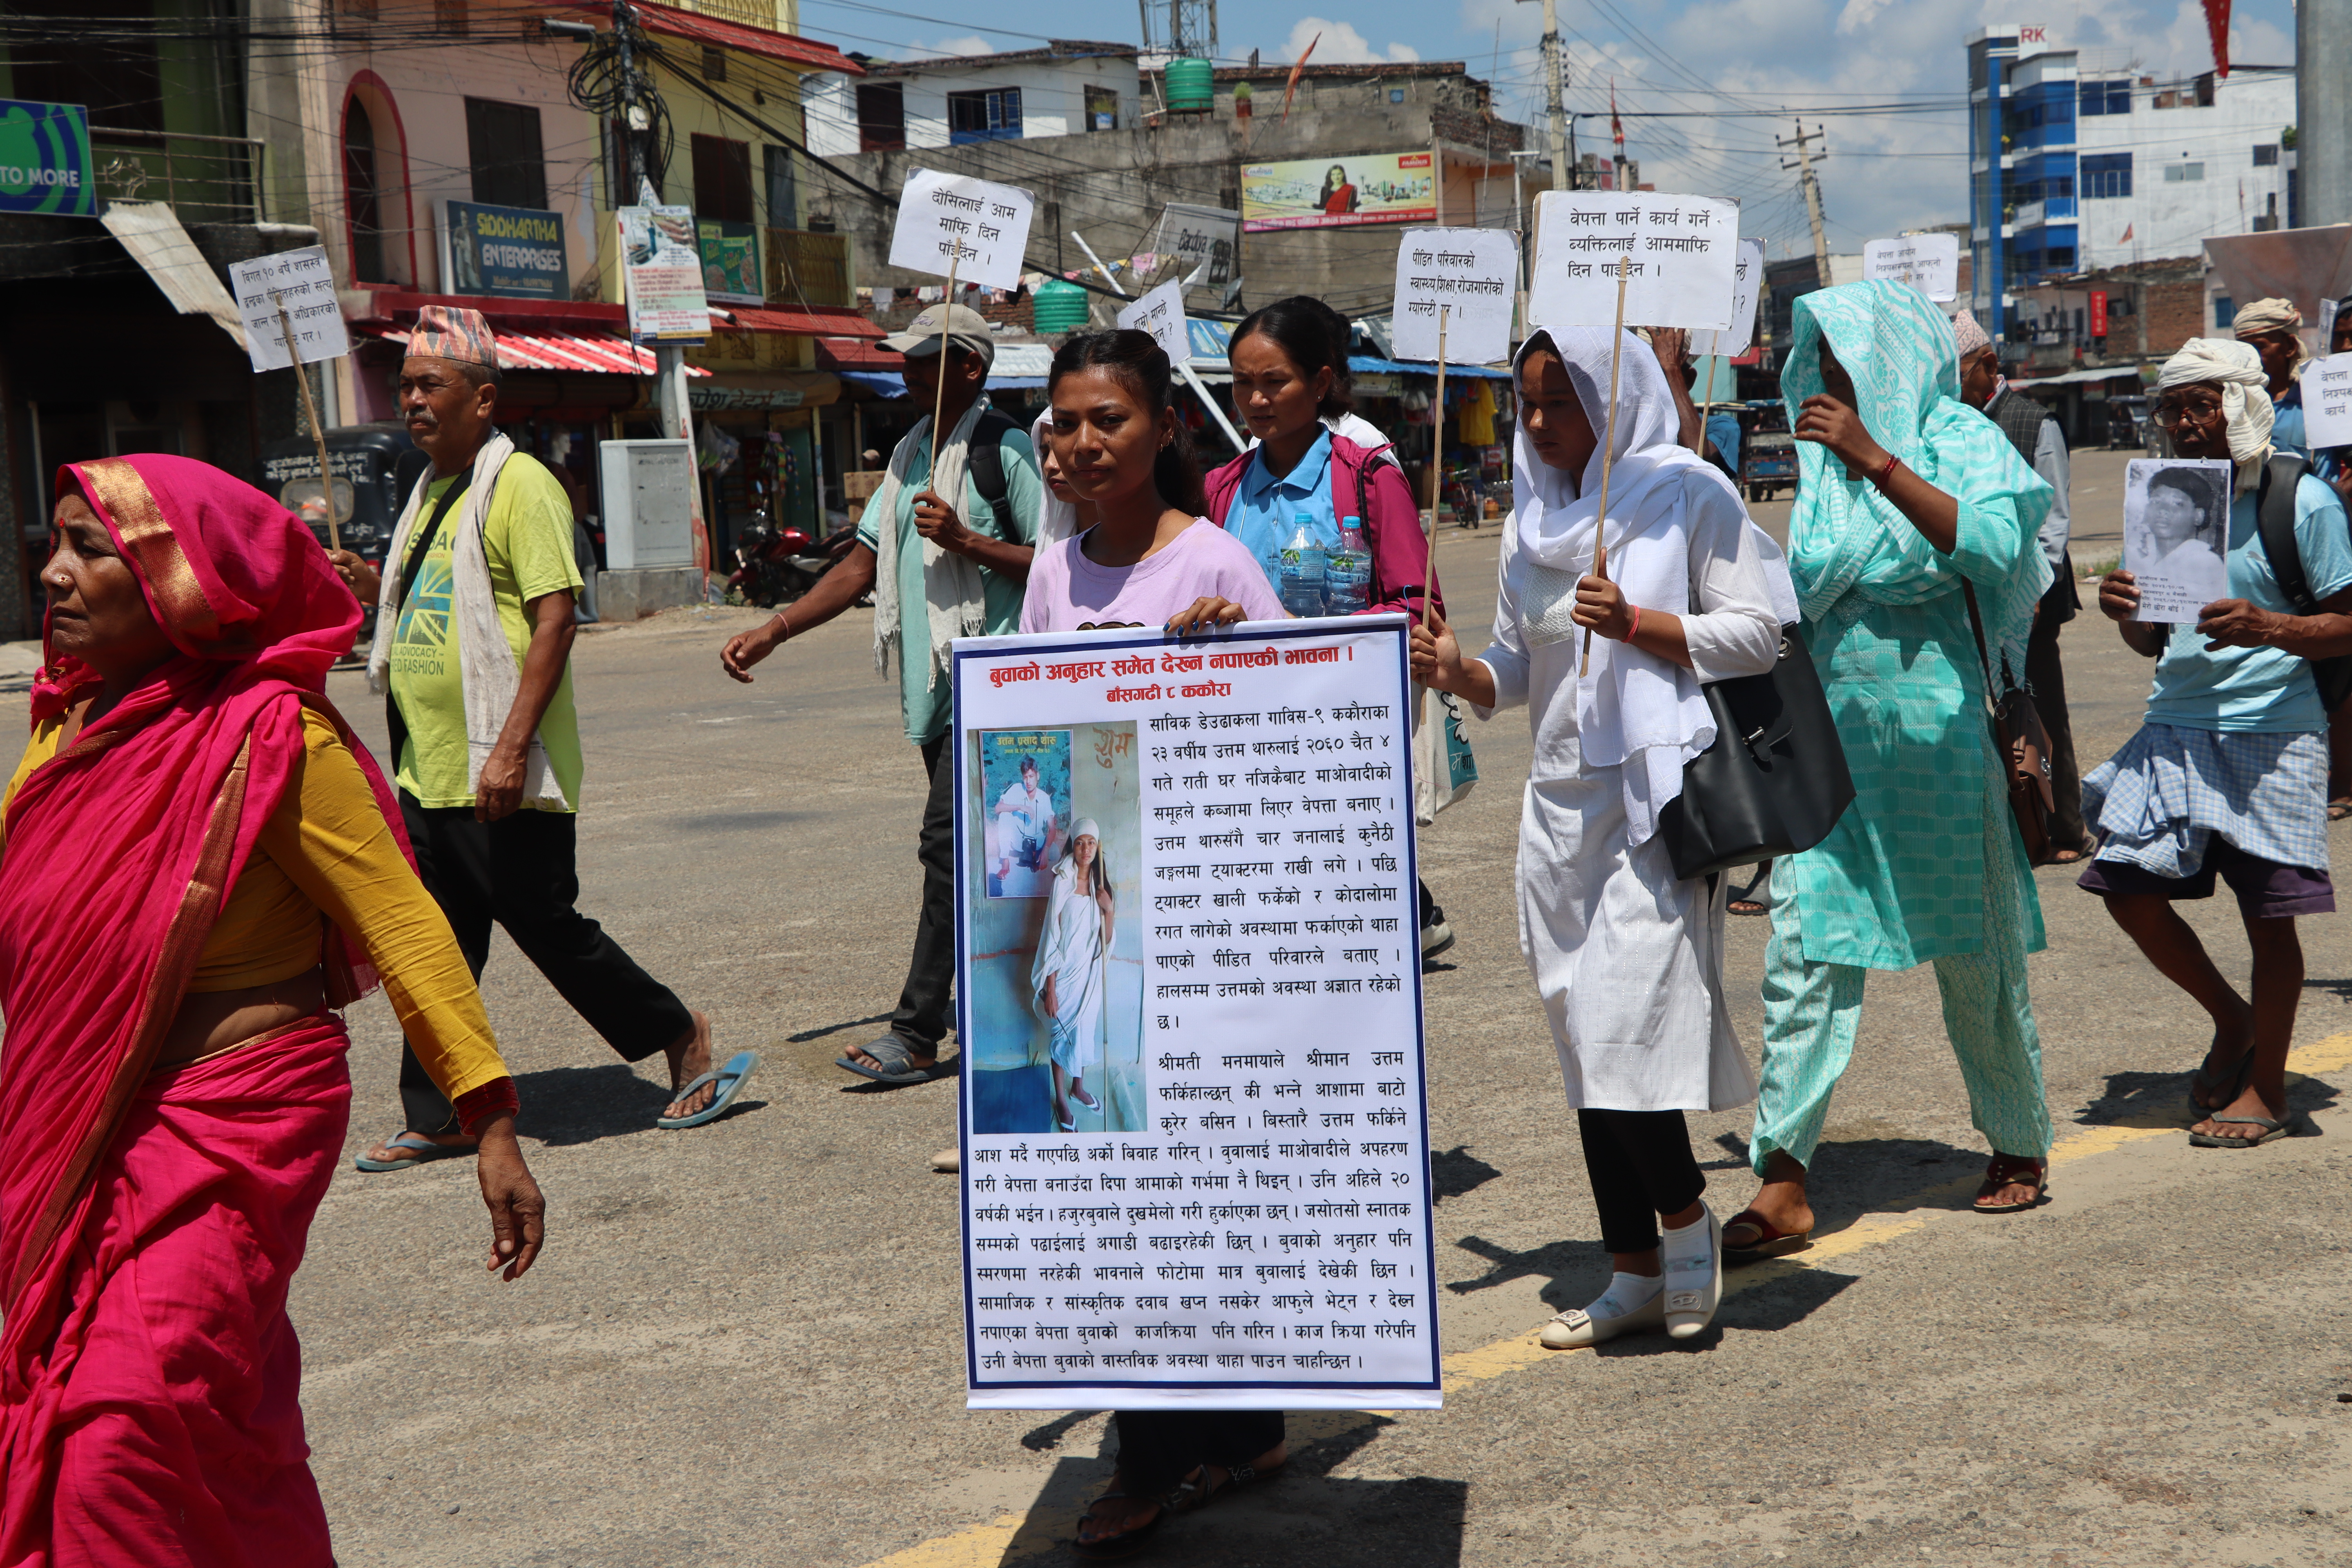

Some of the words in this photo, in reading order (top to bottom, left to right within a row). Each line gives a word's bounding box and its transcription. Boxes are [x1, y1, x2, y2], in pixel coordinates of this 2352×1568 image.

[2021, 27, 2046, 43] RK
[0, 166, 23, 183] TO
[29, 168, 80, 187] MORE
[932, 188, 985, 212] दोसिलाई
[991, 203, 1016, 220] आम
[1649, 208, 1680, 226] कार्य
[1688, 210, 1711, 228] गर्ने
[939, 217, 972, 235] माफि
[978, 222, 1001, 242] दिन
[483, 243, 562, 272] ENTERPRISES
[1413, 248, 1433, 267] पीडित
[1437, 250, 1475, 269] परिवारको
[241, 270, 262, 284] विगत
[263, 268, 274, 281] १०
[1568, 260, 1592, 278] दिन
[293, 299, 337, 321] अधिकारको
[1151, 299, 1167, 320] मान्छे
[301, 331, 314, 343] गर
[2324, 402, 2346, 417] कार्य
[2142, 602, 2151, 610] मेरो
[2154, 603, 2166, 611] छोरा
[400, 646, 437, 658] ADVOCACY
[404, 659, 444, 675] FASHION
[990, 661, 1040, 688] बुवाको
[1045, 661, 1106, 683] अनुहार
[1111, 655, 1155, 677] समेत
[1161, 652, 1204, 673] देख्न
[1209, 646, 1279, 669] नपाएकी
[1285, 647, 1339, 664] भावना
[1107, 683, 1161, 702] बाँसगढी
[1166, 686, 1176, 699] ८
[1181, 679, 1232, 698] ककौरा
[1149, 713, 1191, 731] साविक
[1198, 711, 1260, 729] डेउढाकला
[1332, 701, 1389, 721] ककौराका
[1152, 747, 1167, 762] २३
[1173, 741, 1207, 760] वर्षीय
[1213, 744, 1245, 758] उत्तम
[1252, 735, 1299, 756] थारुलाई
[1307, 738, 1343, 754] २०६०
[1350, 731, 1373, 750] चैत
[1380, 735, 1389, 747] ४
[1152, 773, 1173, 791] गते
[1182, 771, 1209, 789] राती
[1218, 775, 1236, 787] घर
[1245, 766, 1306, 786] नजिकैबाट
[1316, 762, 1392, 782] माओवादीको
[1153, 801, 1195, 825] समूहले
[1261, 798, 1293, 818] लिएर
[1302, 796, 1337, 813] वेपत्ता
[1346, 797, 1381, 813] बनाए
[1284, 856, 1313, 875] राखी
[1323, 855, 1347, 873] लगे
[1371, 853, 1397, 872] पछि
[1213, 889, 1246, 907] खाली
[1258, 886, 1301, 905] फर्केको
[1314, 891, 1322, 903] र
[1334, 883, 1397, 902] कोदालोमा
[1156, 950, 1195, 971] पाएको
[1212, 949, 1251, 967] पीडित
[1269, 946, 1325, 965] परिवारले
[1343, 949, 1378, 965] बताए
[1157, 985, 1210, 999] हालसम्म
[1216, 978, 1265, 997] उत्तमको
[1273, 981, 1317, 995] अवस्था
[1324, 980, 1362, 993] अज्ञात
[1368, 974, 1401, 993] रहेको
[1157, 1016, 1169, 1029] छ
[1159, 1052, 1201, 1071] श्रीमती
[1221, 1050, 1285, 1069] मनमायाले
[1307, 1049, 1350, 1067] श्रीमान
[1371, 1052, 1404, 1065] उत्तम
[1244, 1080, 1261, 1098] की
[1274, 1080, 1302, 1098] भन्ने
[1316, 1083, 1365, 1097] आशामा
[1377, 1077, 1406, 1096] बाटो
[1160, 1112, 1187, 1136] कुरेर
[1200, 1112, 1236, 1129] बसिन
[1263, 1108, 1308, 1128] बिस्तारै
[1320, 1114, 1354, 1127] उत्तम
[1367, 1107, 1407, 1126] फर्किने
[975, 1150, 1001, 1163] आश
[1009, 1143, 1028, 1162] मर्दै
[1036, 1144, 1080, 1165] गएपछि
[1088, 1143, 1114, 1161] अर्को
[1122, 1143, 1158, 1161] बिवाह
[1167, 1142, 1202, 1163] गरिन्
[1278, 1139, 1351, 1158] माओवादीले
[1361, 1143, 1408, 1156] अपहरण
[981, 1351, 1005, 1369] उनी
[1012, 1351, 1047, 1368] बेपत्ता
[1053, 1350, 1095, 1373] बुवाको
[1101, 1350, 1158, 1368] वास्तविक
[1166, 1355, 1209, 1367] अवस्था
[1216, 1355, 1245, 1368] थाहा
[1250, 1355, 1286, 1368] पाउन
